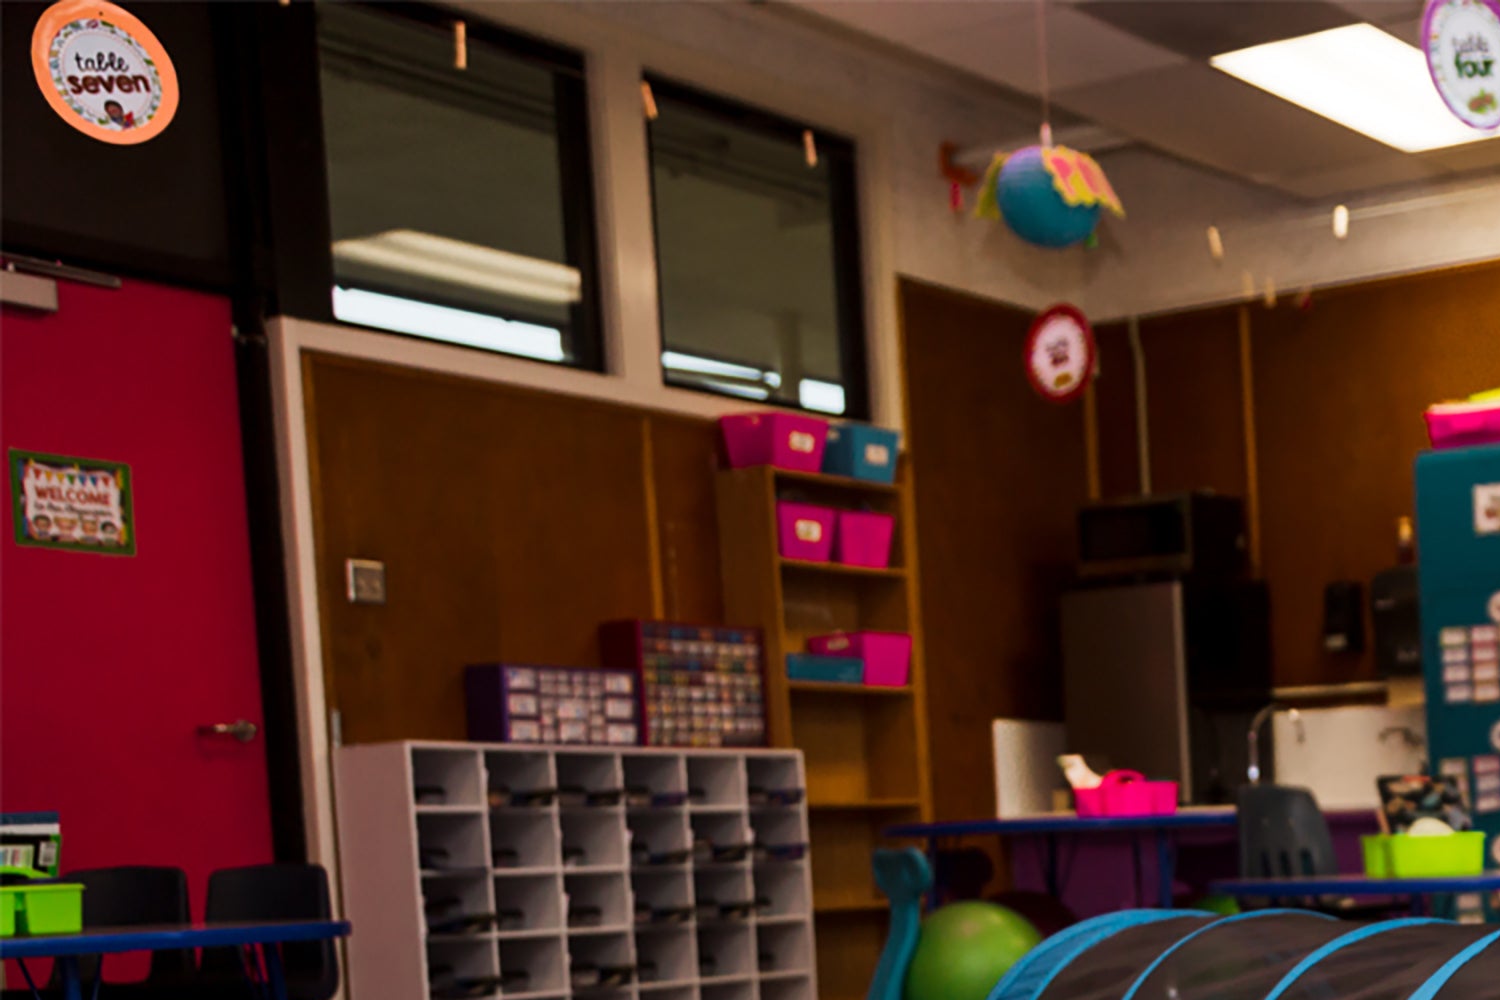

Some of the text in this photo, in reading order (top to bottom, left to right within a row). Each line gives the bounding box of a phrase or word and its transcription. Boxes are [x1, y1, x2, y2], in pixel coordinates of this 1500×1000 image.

[74, 51, 129, 73] table
[66, 74, 151, 95] seven
[35, 486, 111, 505] WELCOME
